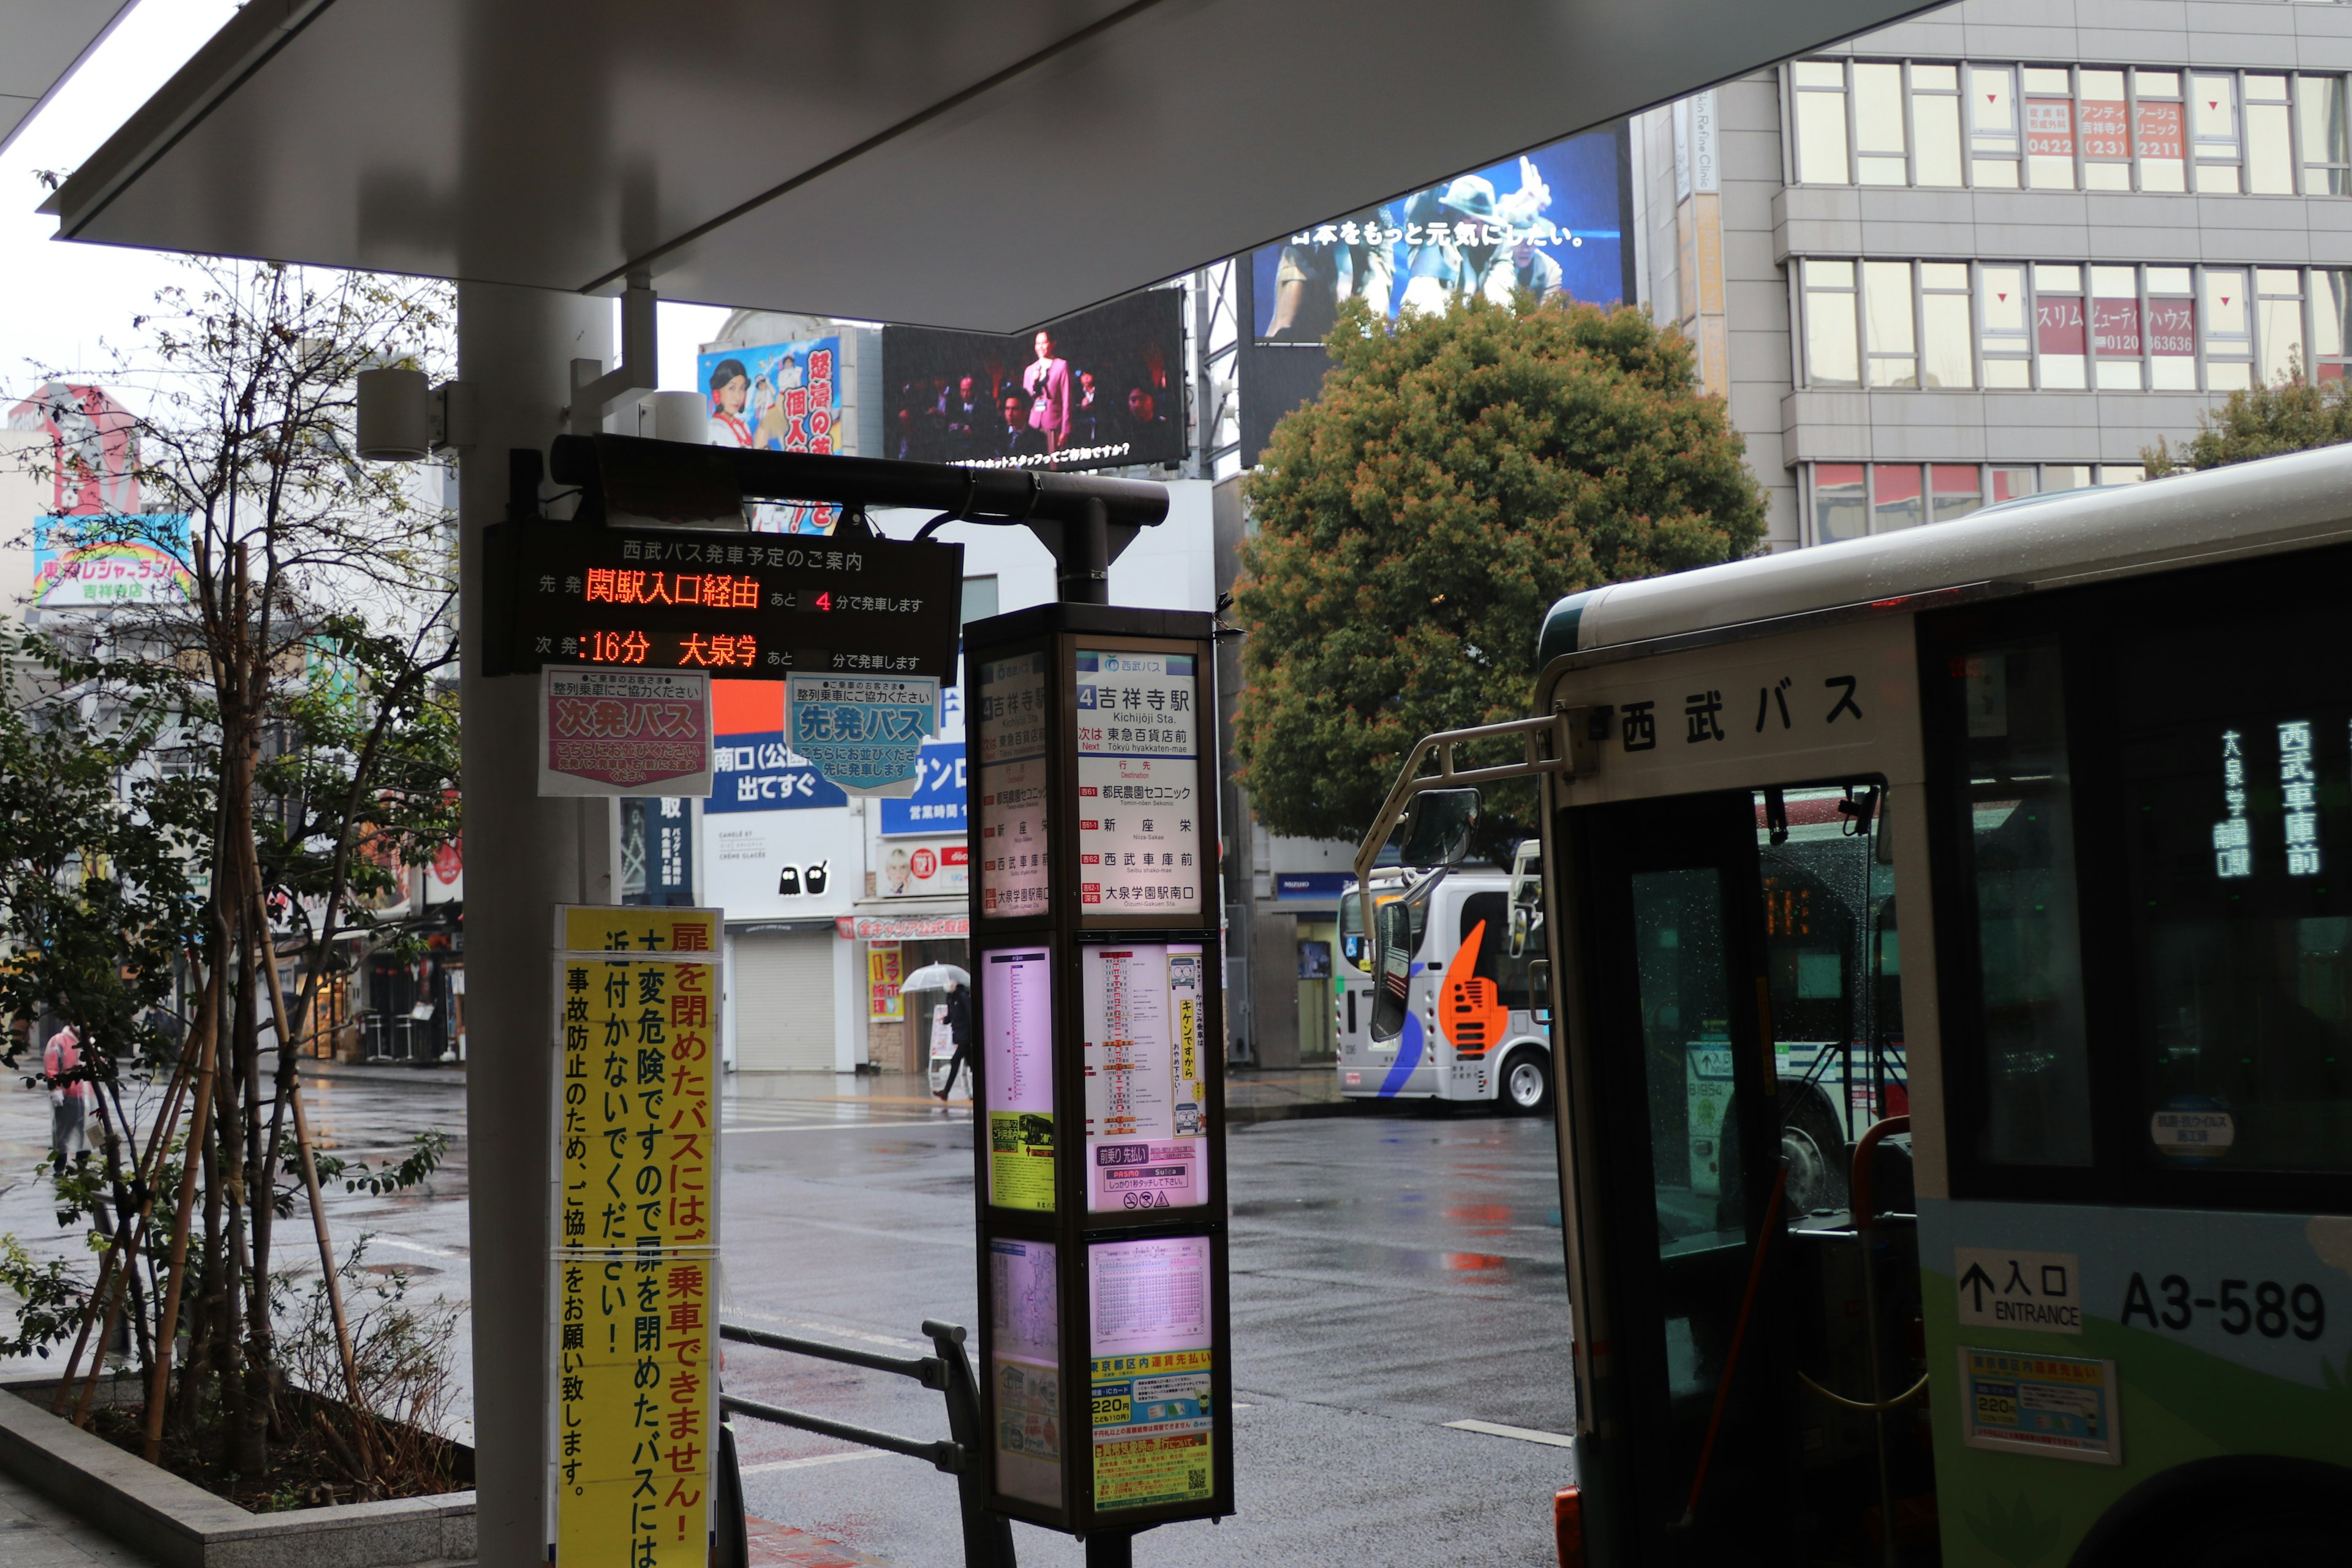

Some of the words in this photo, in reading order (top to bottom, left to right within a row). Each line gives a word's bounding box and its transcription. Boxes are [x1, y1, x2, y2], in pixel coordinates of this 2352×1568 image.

[1697, 115, 1709, 152] Refine
[2082, 121, 2127, 136] 吉祥寺ク
[2028, 138, 2073, 154] 0422
[2084, 141, 2125, 156] (23)
[2138, 141, 2179, 156] 2211
[1699, 154, 1711, 187] Clinic
[2038, 304, 2084, 329] スリム
[2149, 309, 2193, 331] ハウス
[2106, 334, 2140, 350] 0120
[623, 540, 862, 571] 西武バス発車予定のご案内
[539, 575, 582, 594] 先発
[587, 568, 760, 609] 関駅入口経由
[771, 592, 796, 607] あと
[815, 592, 832, 611] 4
[835, 595, 923, 612] 分で発車します
[535, 636, 578, 655] 次発
[767, 651, 793, 666] あと
[832, 653, 920, 670] 分で発車します
[1121, 660, 1161, 673] 西武バス
[553, 682, 699, 698] 整列乗車にご協力ください
[797, 688, 929, 704] 整列乗車にご協力ください
[1079, 688, 1093, 706] 4
[1098, 686, 1190, 712] 吉祥寺駅
[556, 698, 697, 739] 次発バス
[799, 704, 926, 742] 先発バス
[1113, 712, 1154, 725] Kichijōji
[1156, 713, 1177, 724] Sta.
[1620, 676, 1863, 753] 西武バス
[1078, 727, 1102, 741] 次は
[1107, 727, 1187, 744] 東急百貨店前
[556, 742, 699, 759] こちらにお並びください
[1082, 741, 1100, 751] Next
[1107, 742, 1129, 753] Tōkyū
[1131, 743, 1187, 753] hyakkaten-mae
[609, 771, 647, 782] ください
[823, 763, 907, 778] 先に発車します
[1121, 771, 1150, 780] Destination
[737, 772, 816, 802] 出てすぐ
[1080, 788, 1096, 796] 吉61
[1102, 785, 1191, 800] 都民農園セコニック
[2277, 720, 2320, 875] 西武車庫前
[909, 804, 958, 822] 営業時間
[1104, 818, 1192, 832] 新座栄
[1082, 855, 1099, 864] 吉62
[1104, 852, 1193, 867] 西武車庫前
[1084, 894, 1099, 903] 深夜
[1105, 885, 1194, 900] 大泉学園駅南口
[1182, 1000, 1194, 1079] キケンですから
[601, 930, 630, 1353] 近付かないでください!
[1100, 1148, 1121, 1164] 前乗り
[1123, 1147, 1146, 1163] 先払い
[1109, 1178, 1183, 1189] しっかり1秒タッチして下さい。
[562, 967, 590, 1496] 事故防止のため、ご協力をお願い致します。
[664, 922, 709, 1541] 扉を閉めたバスにはご乗車できません!
[630, 929, 666, 1568] 大変危険ですので扉を閉めたバスには
[2003, 1260, 2067, 1297] 入口
[1996, 1301, 2079, 1327] ENTRANCE
[2120, 1272, 2326, 1341] A3-589
[1091, 1357, 1148, 1373] 東京都区内
[1152, 1352, 1211, 1368] 運賃先払い
[1091, 1386, 1128, 1396] 現金・ICカード
[1091, 1398, 1129, 1414] 220円
[1093, 1422, 1191, 1438] 千円札以上の高額紙幣は両替できません
